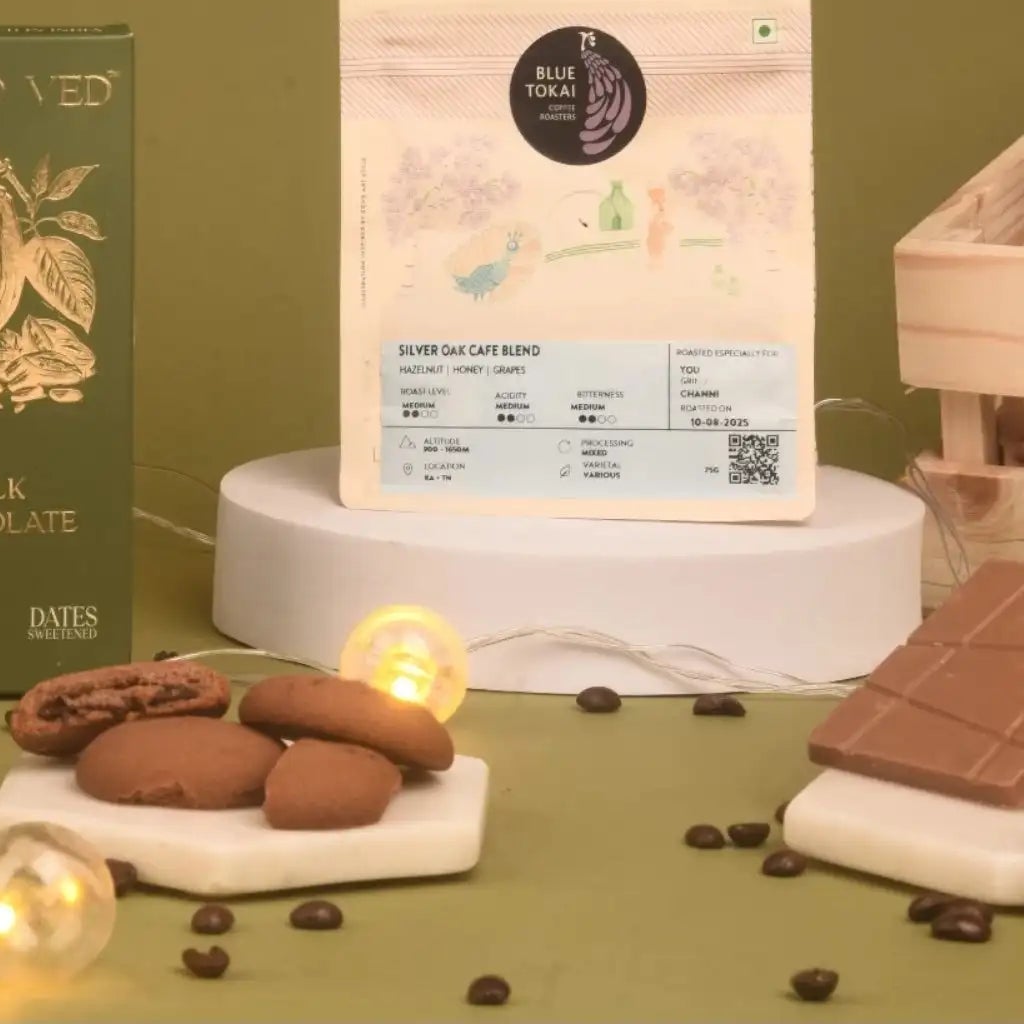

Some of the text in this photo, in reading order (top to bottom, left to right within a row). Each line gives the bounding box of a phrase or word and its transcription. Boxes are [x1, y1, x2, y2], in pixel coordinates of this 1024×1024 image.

[536, 65, 576, 80] BLUE
[525, 83, 576, 98] TOKAI
[539, 113, 576, 121] ROASTERS
[399, 344, 541, 356] SILVER OAK CAFE BLEND
[400, 364, 526, 374] HAZELNUT HONEY GRAPES
[680, 365, 700, 374] YOU
[495, 392, 527, 400] ACIDITY
[577, 389, 624, 398] BITTERNESS
[495, 402, 530, 410] MEDIUM
[571, 403, 606, 411] MEDIUM
[690, 417, 749, 427] 10-08-2025
[581, 439, 634, 447] PROCESSING
[424, 462, 465, 470] LOCATION
[583, 472, 621, 480] VARIOUS
[29, 605, 98, 628] DATES
[27, 628, 98, 640] SWEETENED
